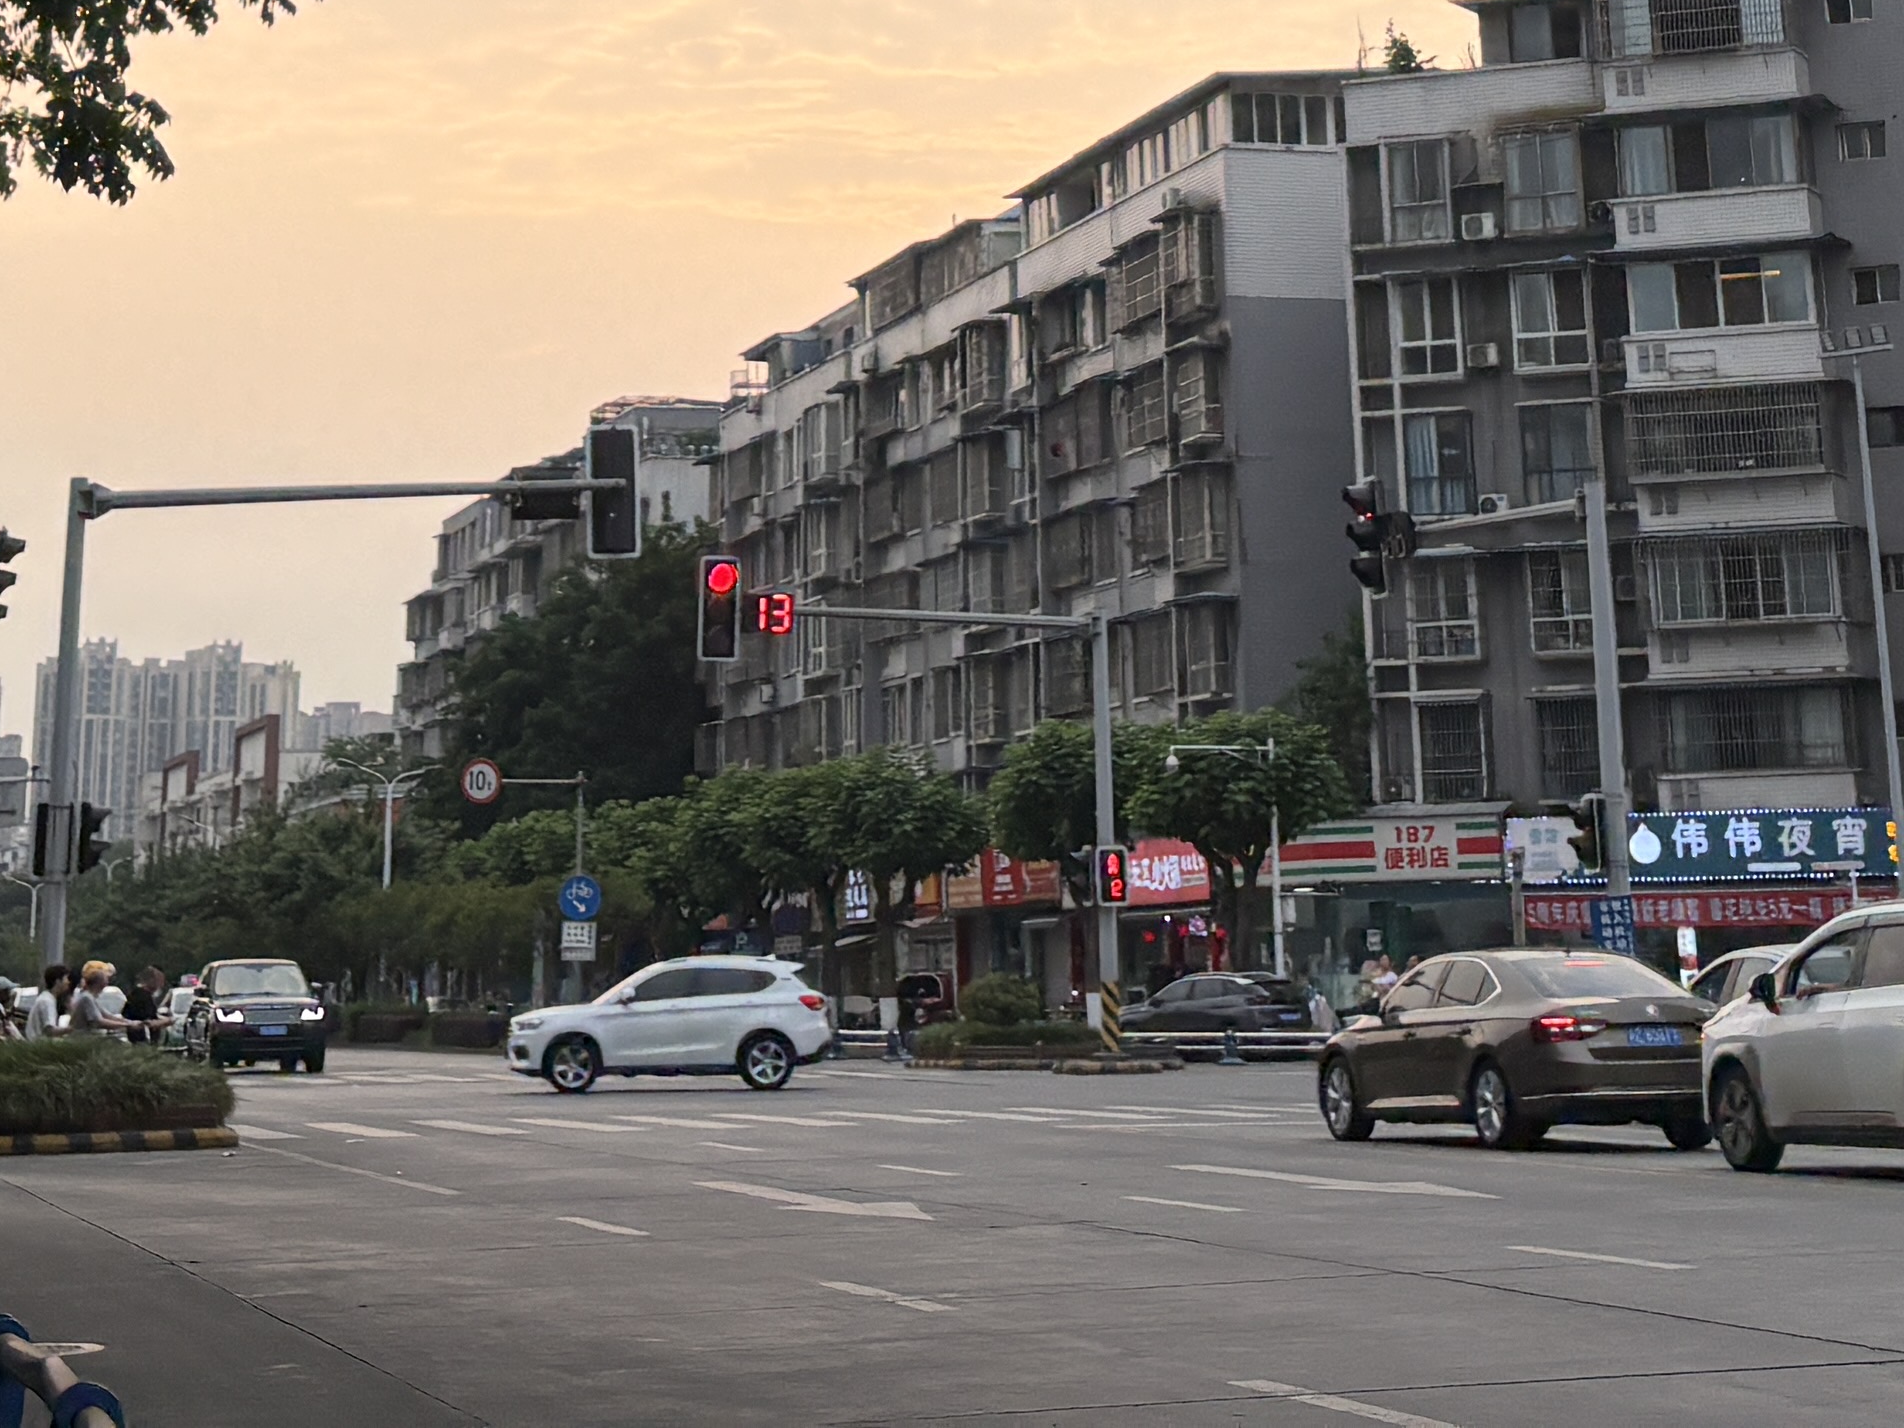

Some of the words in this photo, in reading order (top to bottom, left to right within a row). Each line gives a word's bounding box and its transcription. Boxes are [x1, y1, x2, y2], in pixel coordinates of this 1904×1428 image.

[759, 593, 793, 633] 13
[1395, 825, 1435, 843] 187
[1671, 815, 1867, 859] 伟伟夜宵
[1385, 846, 1449, 870] 便利店
